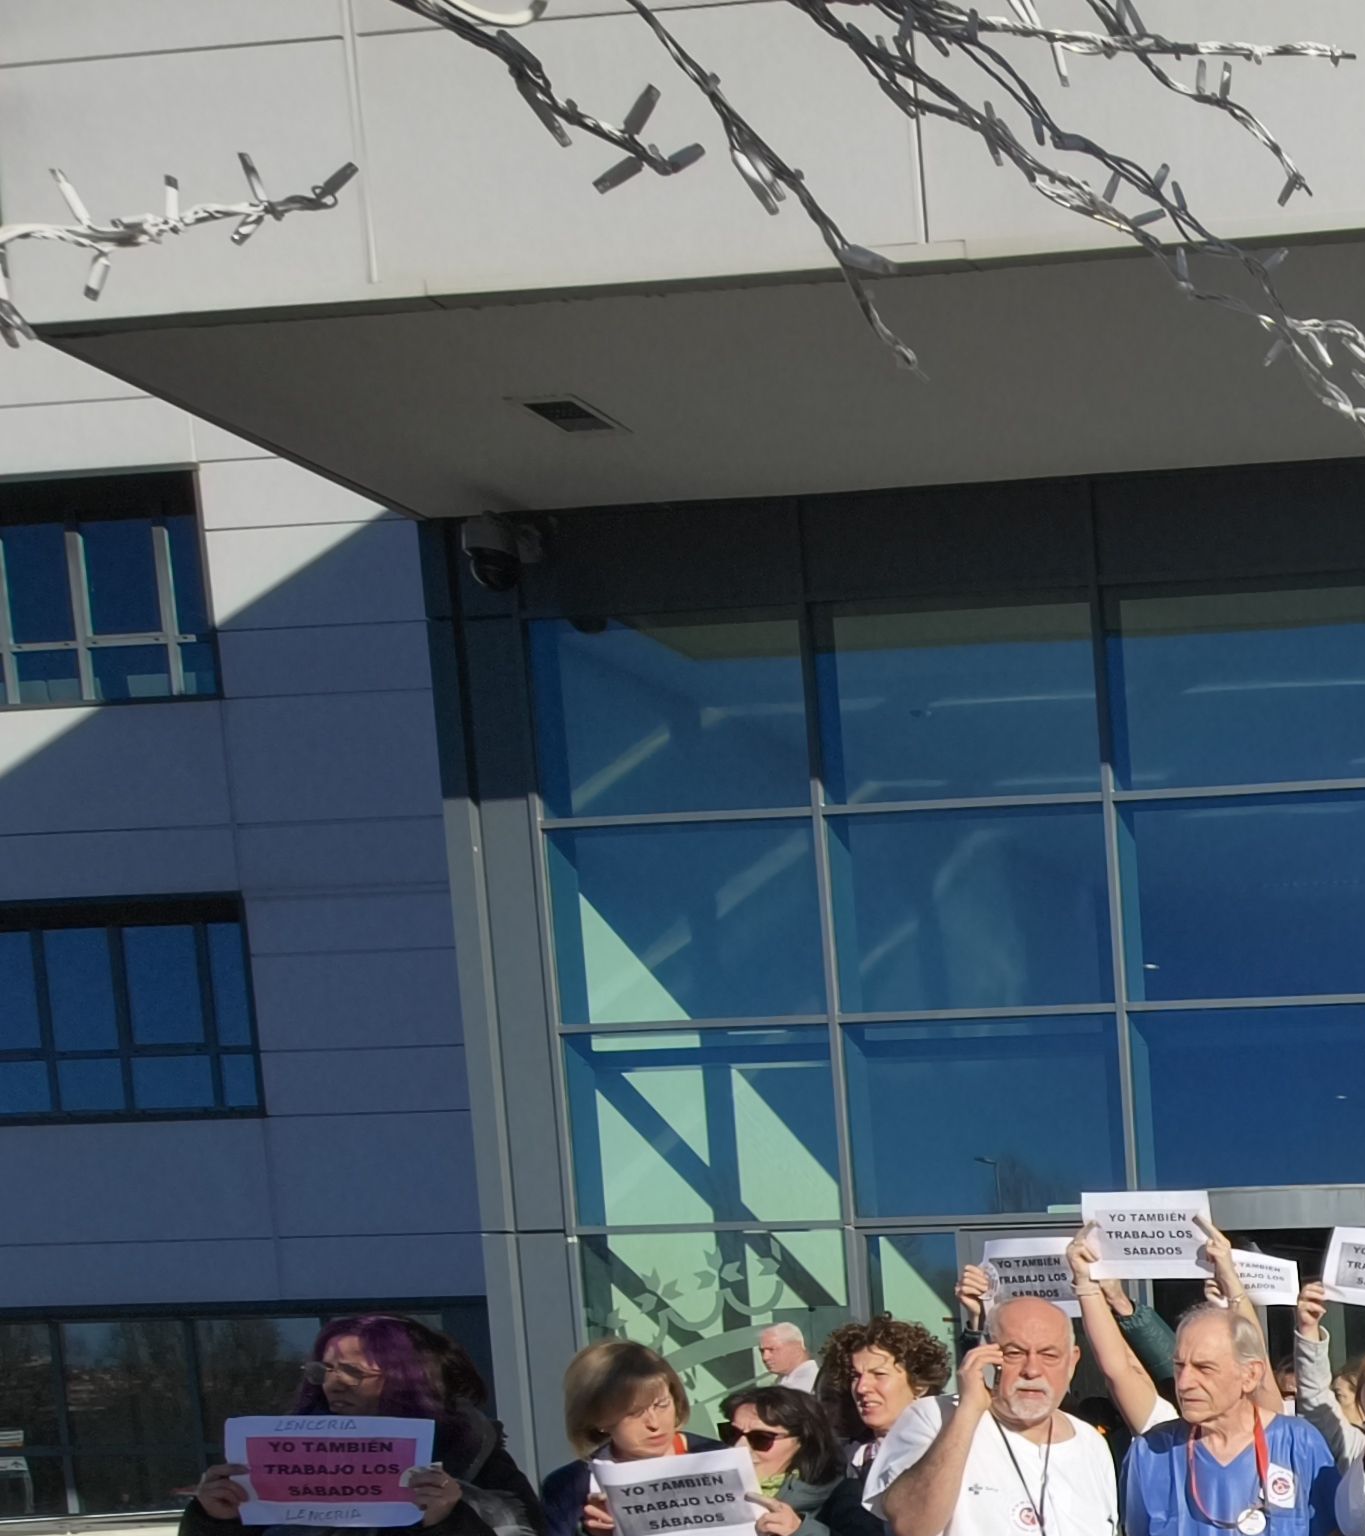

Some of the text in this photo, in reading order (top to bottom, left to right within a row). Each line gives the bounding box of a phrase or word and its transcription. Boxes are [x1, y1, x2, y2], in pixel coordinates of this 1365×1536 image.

[1108, 1212, 1187, 1223] YO TAMBIÉN
[1106, 1230, 1193, 1239] TRABAJO LOS
[1123, 1245, 1183, 1256] SÁBADOS
[997, 1257, 1061, 1268] YO TAMBIÉN
[999, 1272, 1067, 1284] TRABAJO LOS
[268, 1440, 393, 1453] YO TAMBIÉN
[263, 1463, 400, 1475] TRABAJO LOS
[620, 1474, 724, 1497] YO TAMBIÉN
[621, 1493, 735, 1515] TRABAJO LOS
[649, 1512, 725, 1530] SÁBADOS
